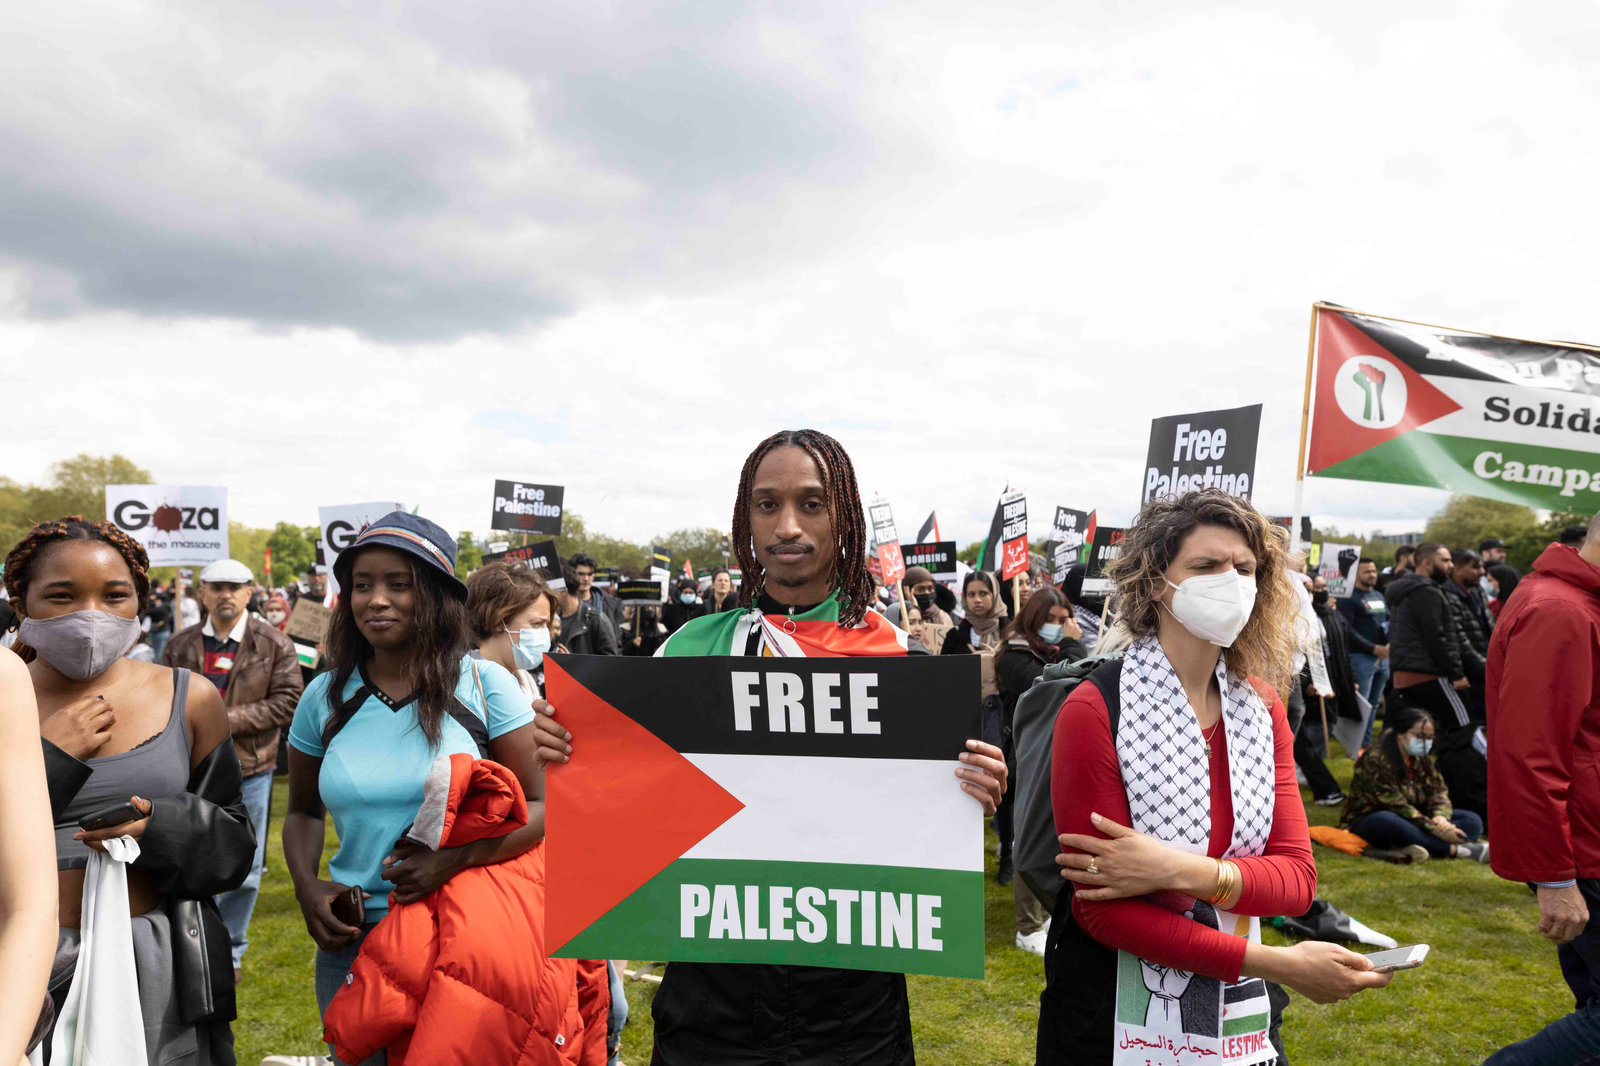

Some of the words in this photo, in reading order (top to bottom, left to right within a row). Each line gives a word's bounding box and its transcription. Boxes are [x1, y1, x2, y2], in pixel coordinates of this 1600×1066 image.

[1173, 423, 1227, 462] Free
[513, 483, 545, 501] Free
[1144, 465, 1249, 503] Palestine
[114, 499, 219, 532] Gza
[495, 496, 561, 518] Palestine
[148, 541, 167, 549] the
[171, 541, 221, 549] massacre
[504, 547, 533, 562] STOP
[914, 544, 937, 554] STOP
[906, 552, 948, 565] BOMBING
[731, 671, 881, 735] FREE
[680, 883, 943, 952] PALESTINE
[1222, 1031, 1268, 1058] LESTINE
